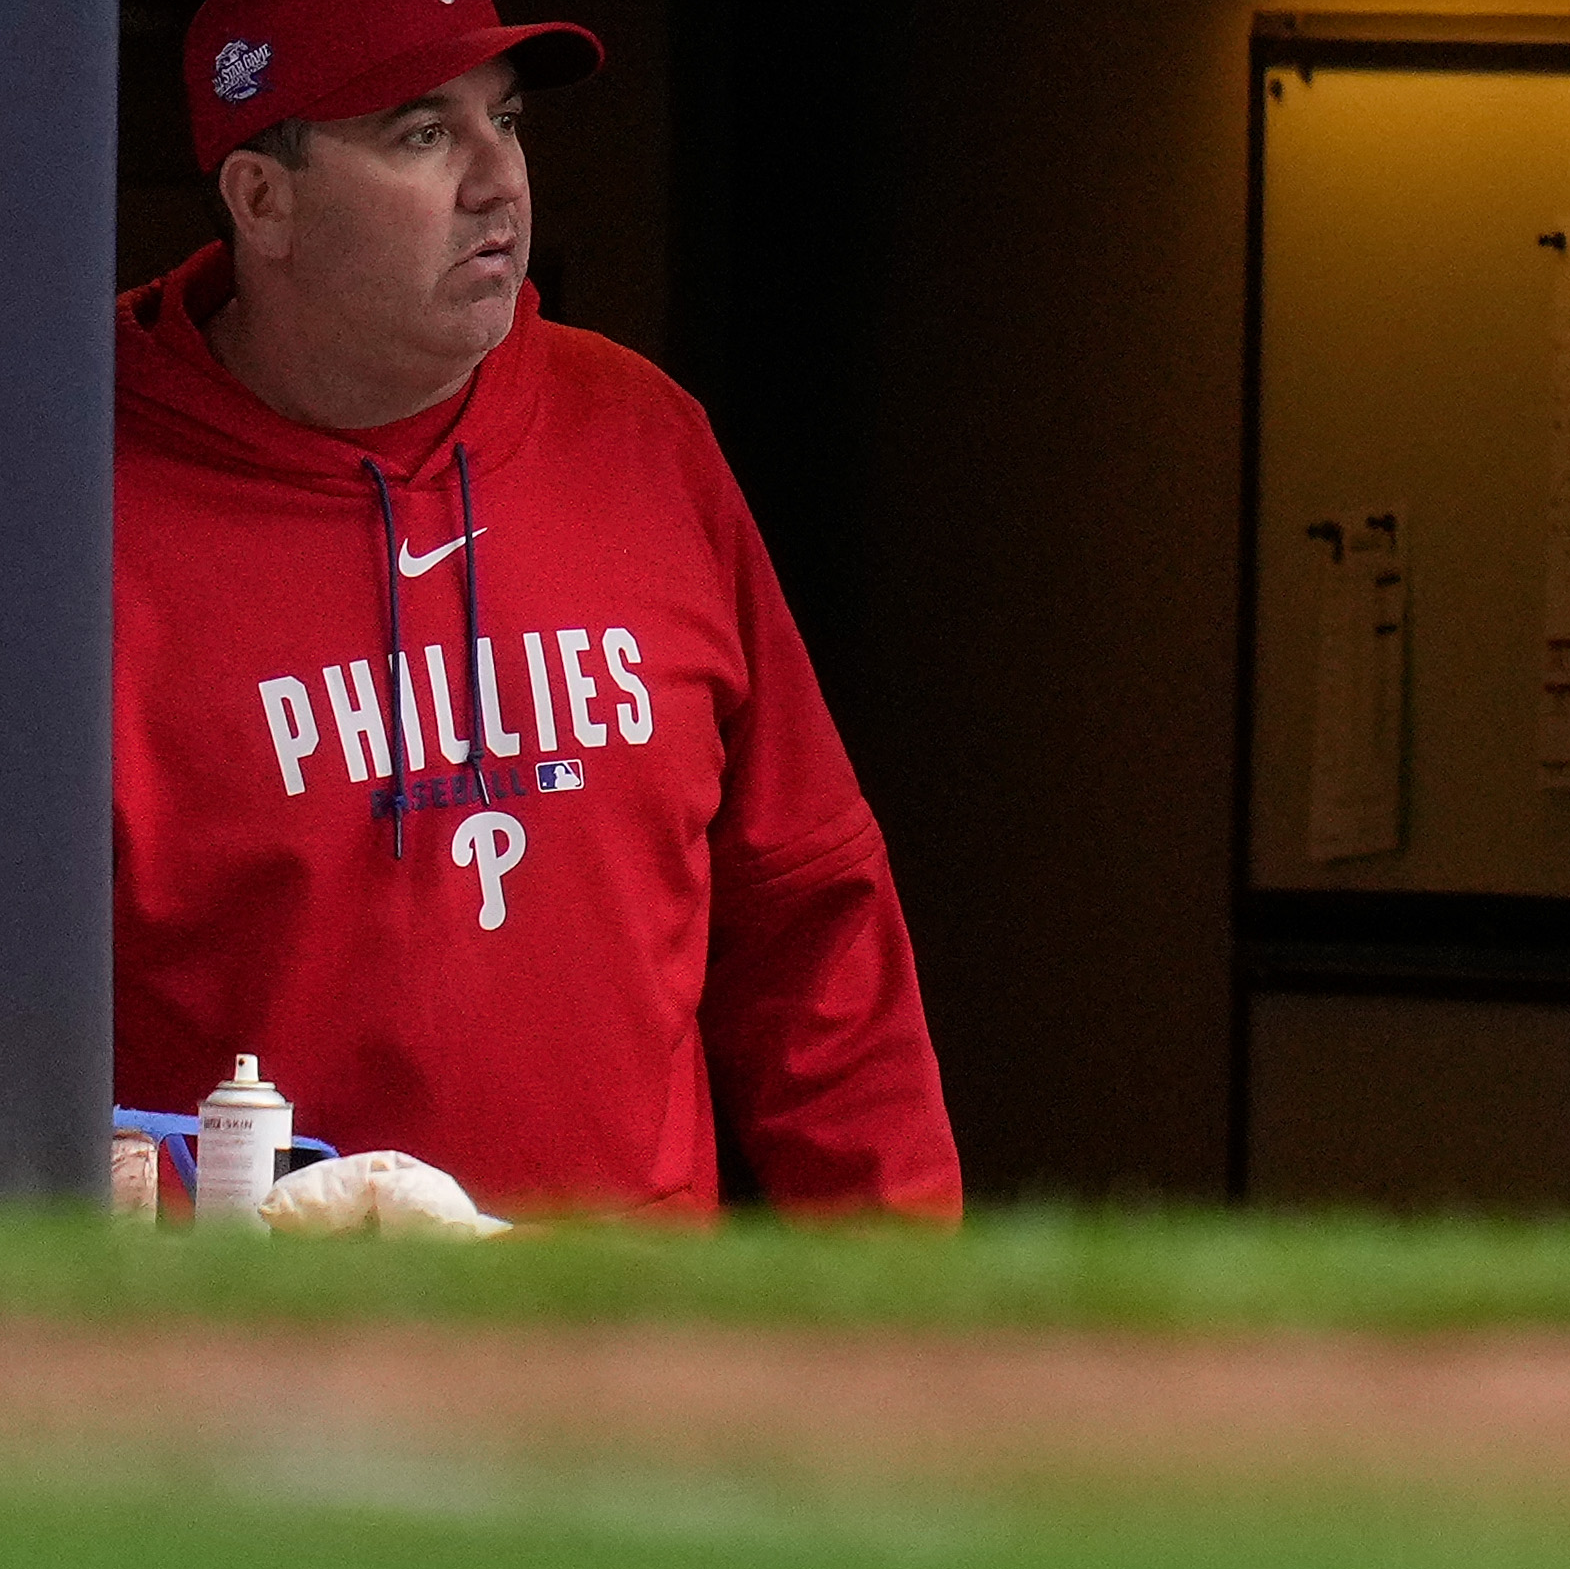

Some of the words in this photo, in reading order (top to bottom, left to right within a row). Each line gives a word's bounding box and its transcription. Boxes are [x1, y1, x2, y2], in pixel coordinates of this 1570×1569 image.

[243, 43, 271, 70] GAME
[258, 627, 654, 797] PHILLIES
[371, 767, 529, 820] BSEBLL
[452, 811, 527, 931] P
